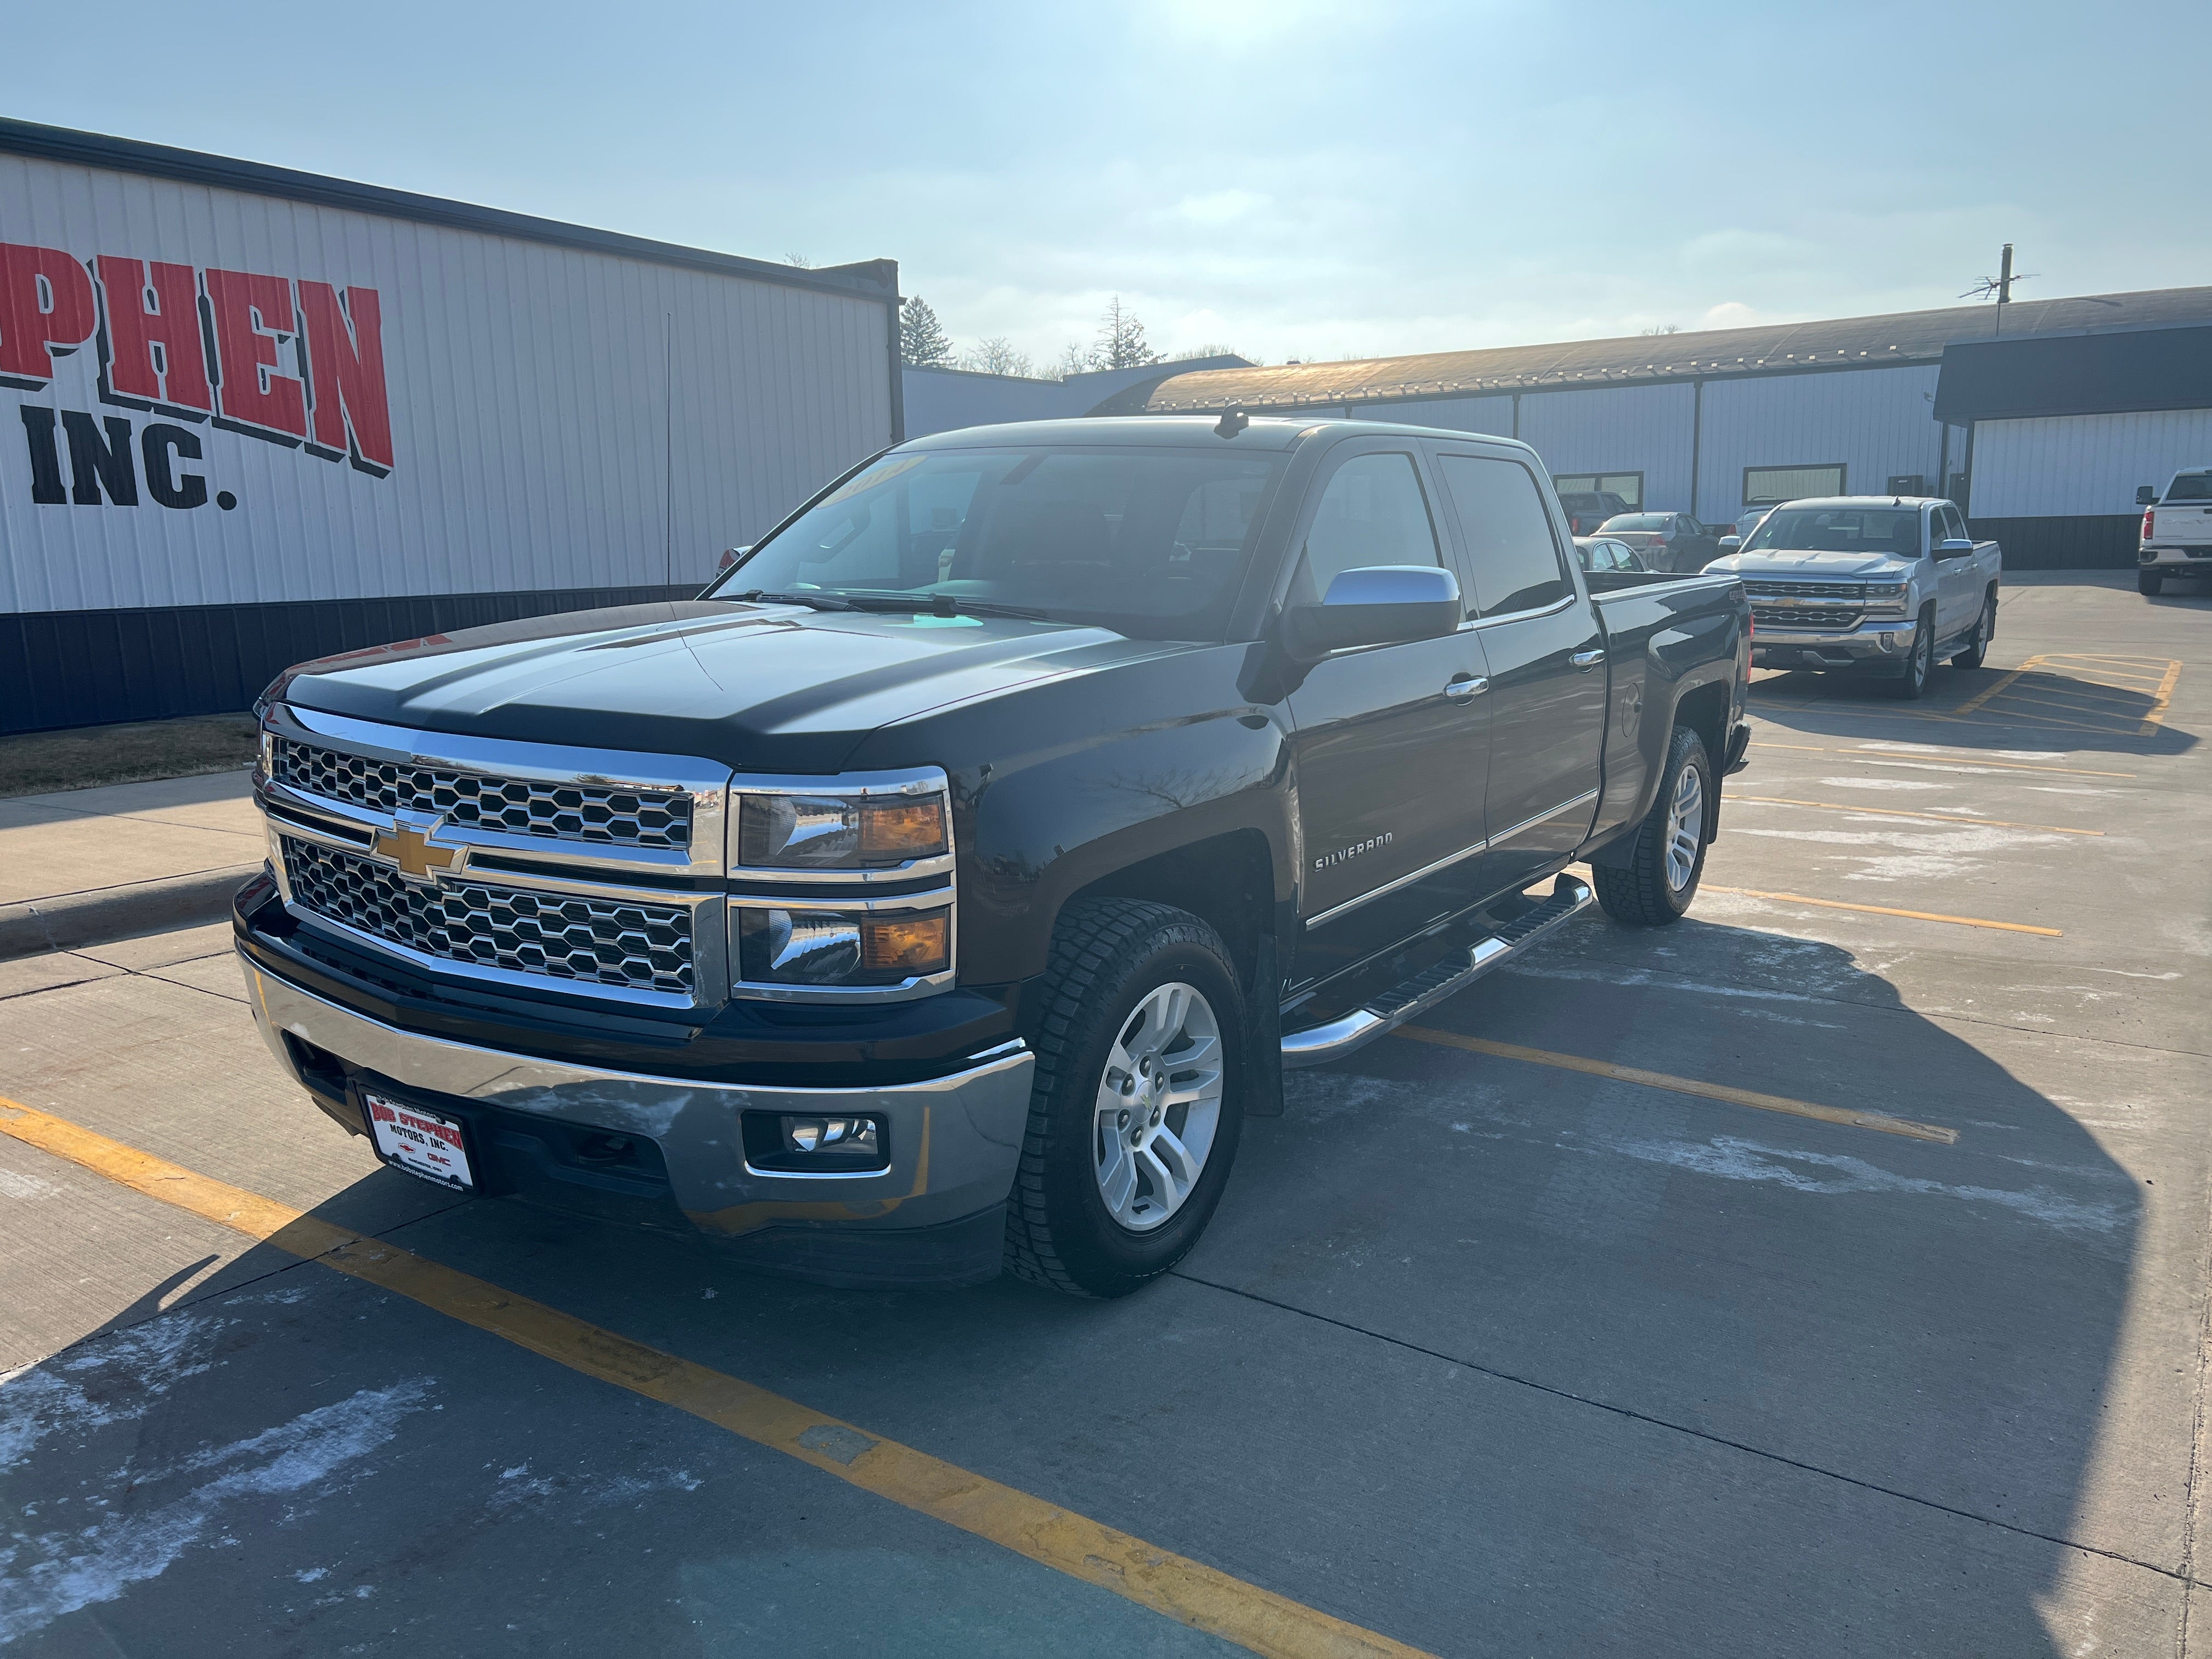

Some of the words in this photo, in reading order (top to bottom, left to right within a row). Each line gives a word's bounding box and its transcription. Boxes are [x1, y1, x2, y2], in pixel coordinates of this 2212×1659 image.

[20, 405, 237, 510] INC.
[1313, 832, 1393, 872] SILVERADO
[369, 1101, 396, 1122] BOB
[398, 1112, 464, 1152] STEPHEN
[390, 1124, 428, 1147] MOTORS,
[430, 1137, 449, 1151] INC.
[388, 1159, 464, 1192] www.bobstephenmotors.com
[427, 1153, 452, 1167] GMC
